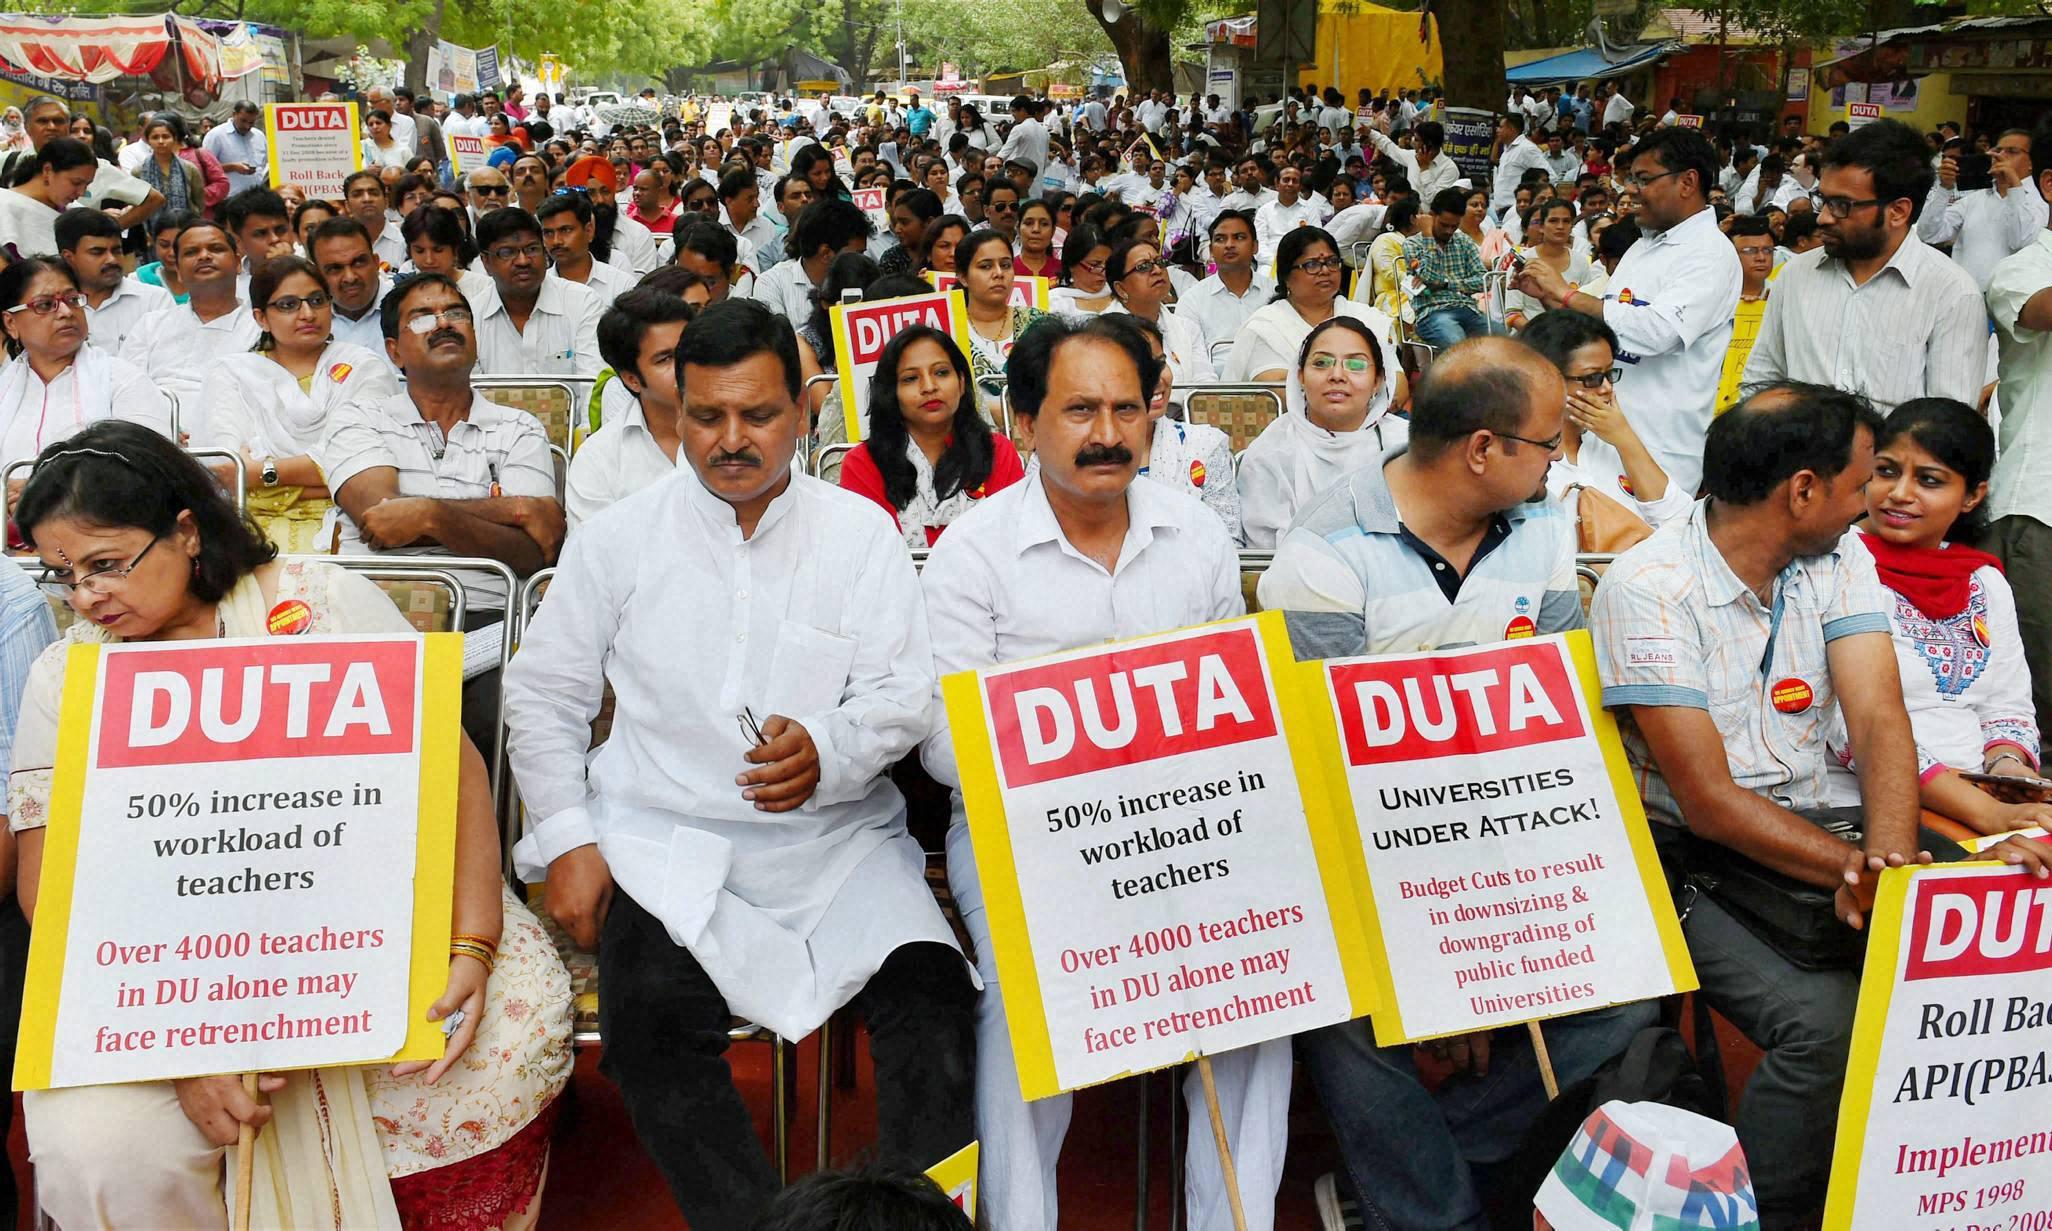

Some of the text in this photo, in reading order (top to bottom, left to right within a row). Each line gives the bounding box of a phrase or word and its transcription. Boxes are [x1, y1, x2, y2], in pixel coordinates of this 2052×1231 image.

[281, 111, 345, 128] DUTA
[1680, 118, 1697, 126] DUTA
[1852, 105, 1877, 116] DUTA
[455, 138, 483, 152] DUTA
[289, 169, 345, 180] Roll Back
[127, 661, 392, 748] DUTA
[1013, 653, 1255, 766] DUTA
[1354, 662, 1564, 748] DUTA
[126, 782, 383, 819] 50% increase in
[1046, 769, 1266, 832] 50% increase in
[1378, 767, 1575, 811] UNIVERSITIES
[153, 822, 346, 857] workload of
[1080, 809, 1244, 866] workload of
[1372, 797, 1601, 850] UNDER ATTACK!
[176, 868, 315, 897] teachers
[1111, 858, 1230, 899] teachers
[1399, 852, 1606, 899] Budget Cuts to result
[1428, 885, 1590, 926] in downsizing &
[96, 926, 384, 966] Over 4000 teachers
[1060, 904, 1304, 973] Over 4000 teachers
[1438, 913, 1598, 954] downgrading of
[1090, 947, 1291, 1010] in DU alone may
[1454, 944, 1596, 989] public funded
[117, 969, 358, 1008] in DU alone may
[1470, 981, 1595, 1016] Universities
[94, 1009, 373, 1053] face retrenchment
[1083, 980, 1316, 1054] face retrenchment
[1917, 998, 1995, 1039] Roll
[1892, 1051, 2052, 1106] API(PBA
[1917, 1178, 2025, 1216] MPS 1998
